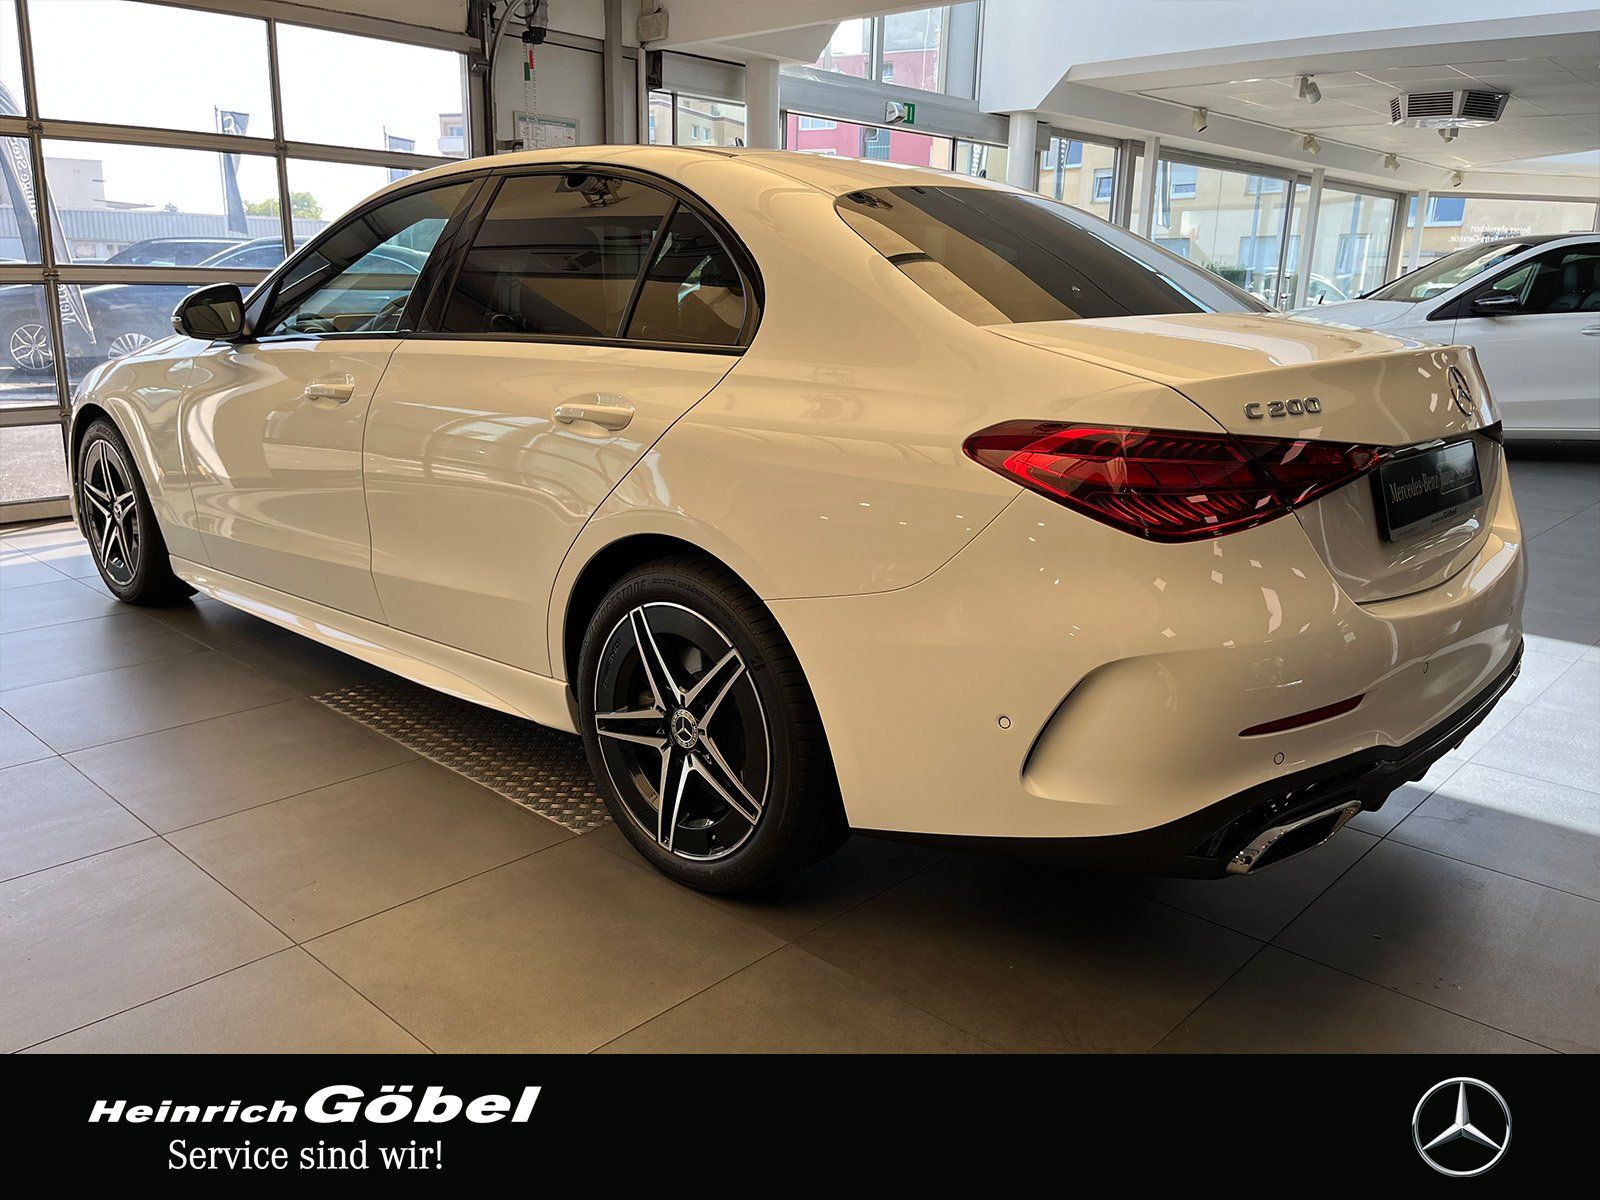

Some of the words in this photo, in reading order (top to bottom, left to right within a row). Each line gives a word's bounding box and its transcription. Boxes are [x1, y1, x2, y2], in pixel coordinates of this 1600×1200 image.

[1243, 402, 1264, 420] C
[1267, 396, 1322, 418] 200
[1389, 473, 1440, 504] Mercedes-Benz
